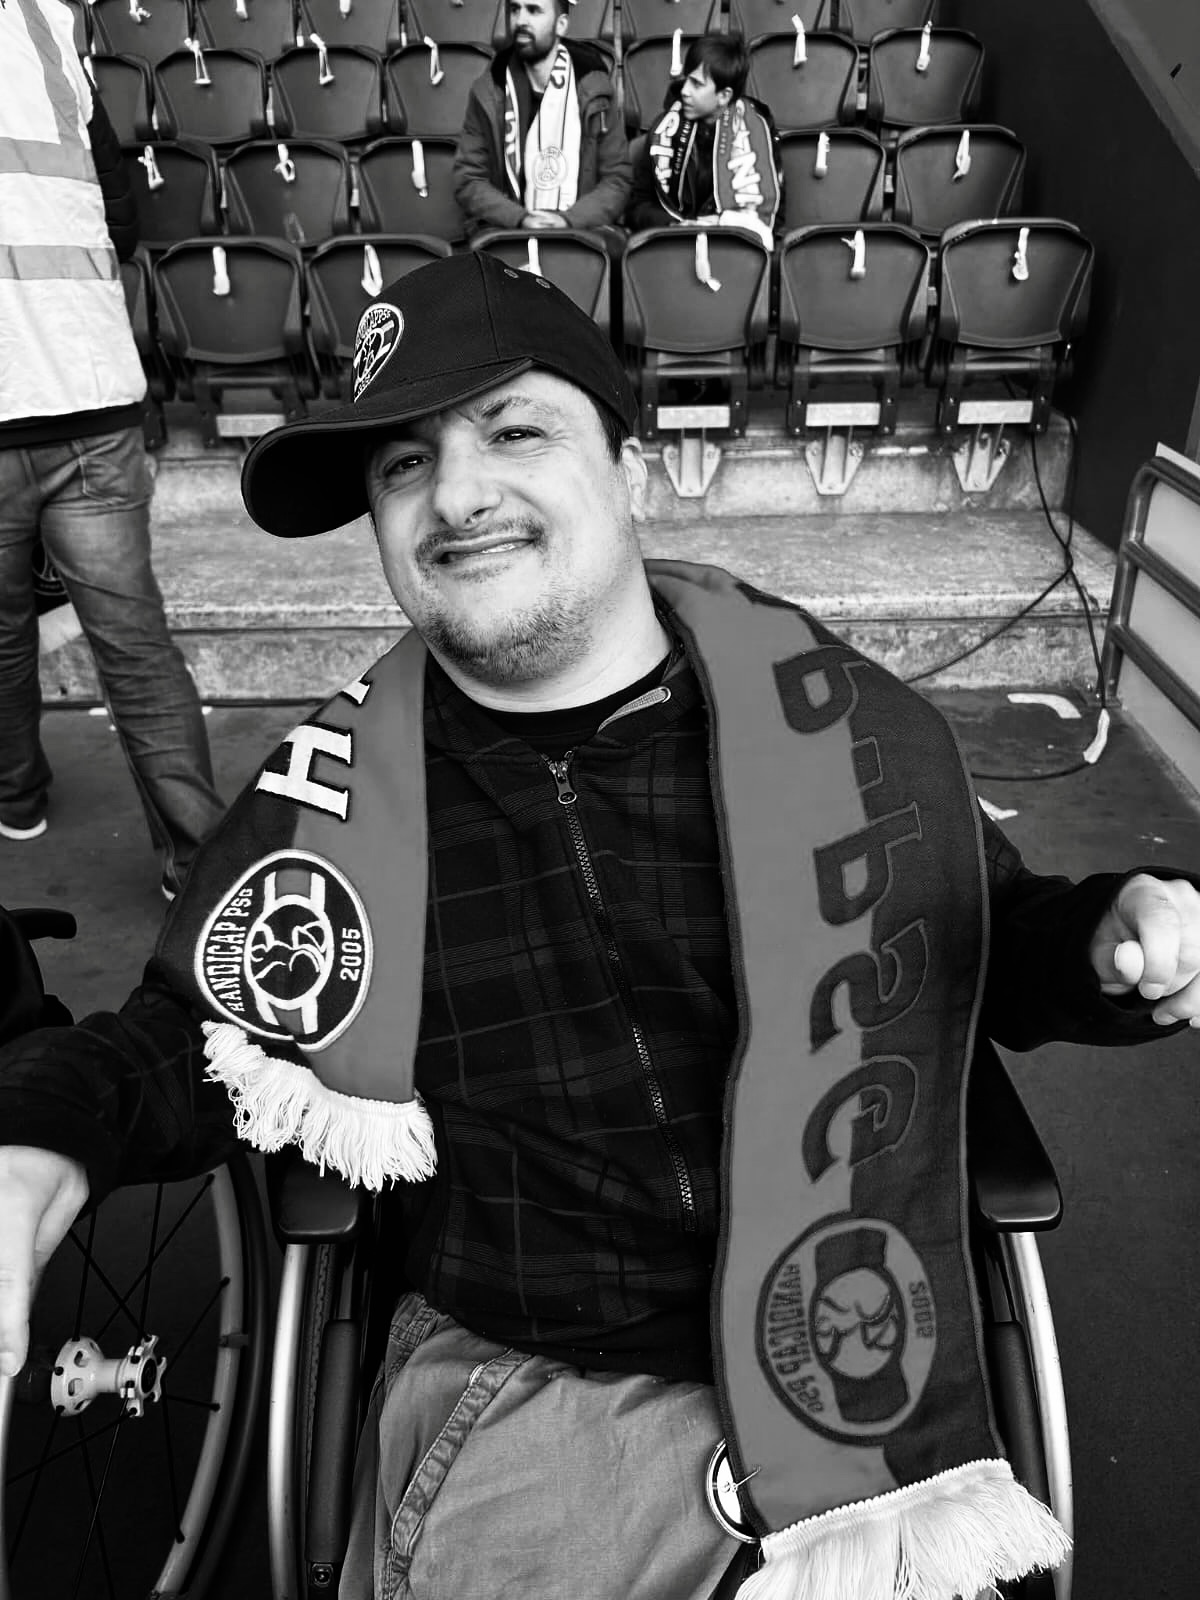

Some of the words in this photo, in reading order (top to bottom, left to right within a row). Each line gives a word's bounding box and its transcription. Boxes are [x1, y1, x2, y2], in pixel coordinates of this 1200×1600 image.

[255, 672, 370, 820] H
[222, 888, 253, 917] PSG
[206, 921, 246, 1012] HANDICAP
[339, 927, 362, 982] 2005
